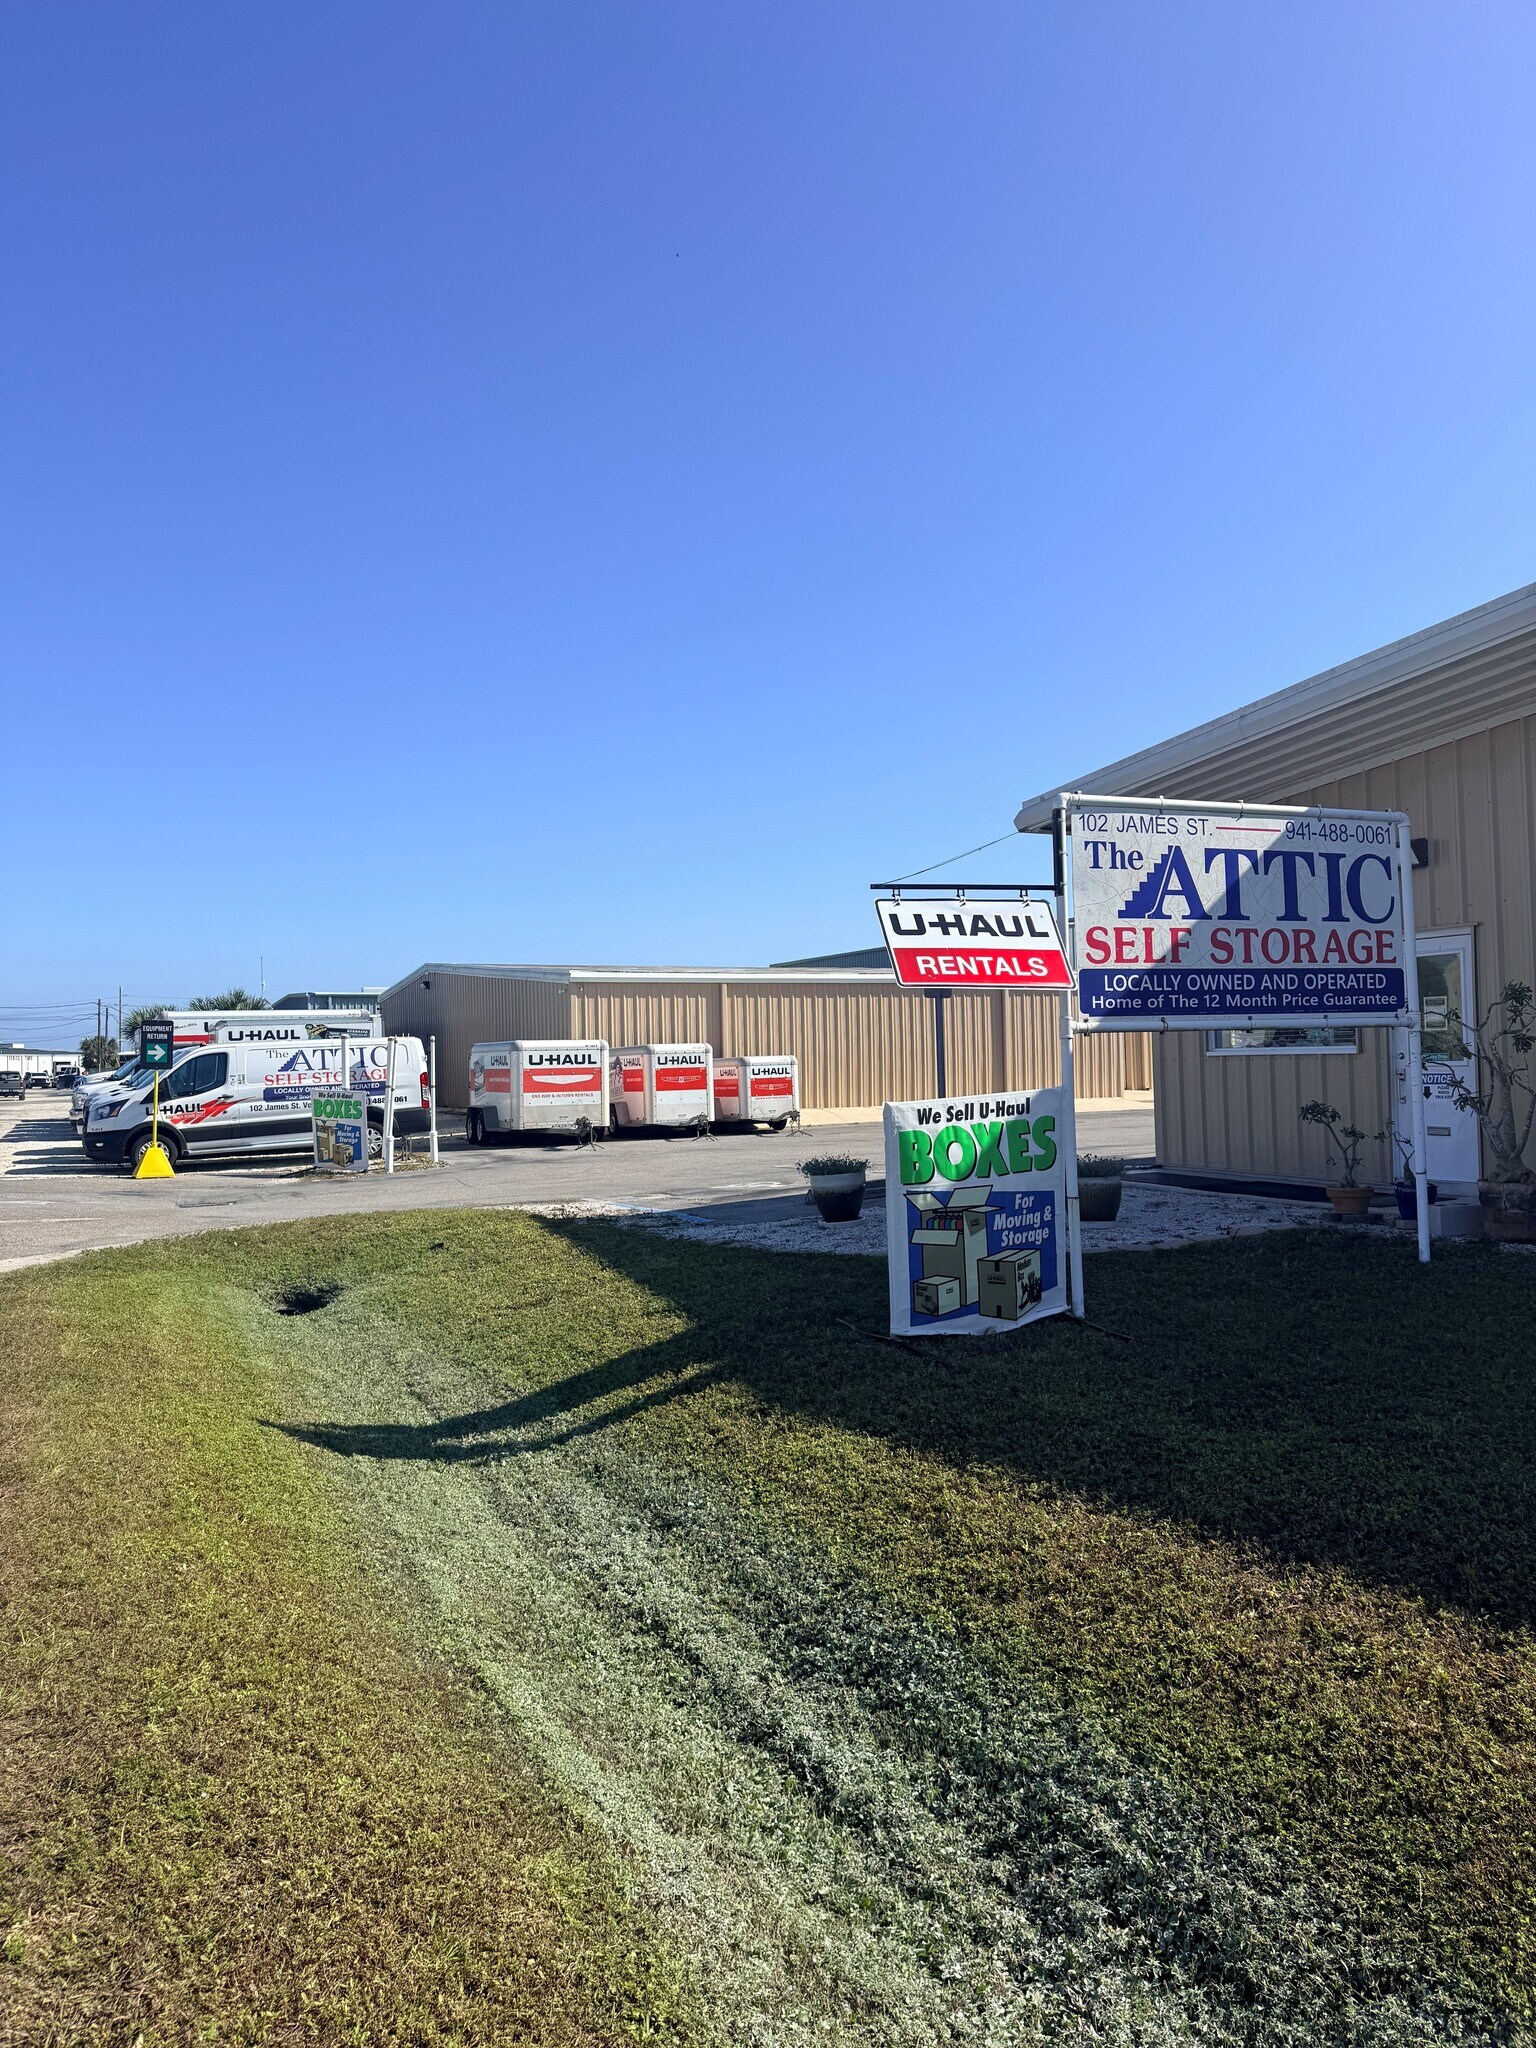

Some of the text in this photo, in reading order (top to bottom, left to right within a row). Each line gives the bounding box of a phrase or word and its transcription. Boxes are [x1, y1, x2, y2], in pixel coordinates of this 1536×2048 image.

[1078, 813, 1213, 837] 102 JAMES ST.
[1285, 821, 1392, 845] 941-488-0061
[1084, 840, 1395, 924] The ATTIC
[888, 913, 1050, 938] U-HAUL
[1085, 926, 1397, 965] SELF STORAGE
[915, 955, 1048, 977] RENTALS
[1104, 973, 1387, 992] LOCALLY OWNED AND OPERATED
[1092, 993, 1398, 1009] Home of The 12 Month Price Guarantee
[228, 1029, 300, 1041] U-HAUL
[266, 1050, 289, 1059] The
[528, 1053, 597, 1065] U-HAUL
[657, 1055, 705, 1065] U-HAUL
[264, 1072, 308, 1086] SELF
[751, 1067, 791, 1076] U-HAUL
[1422, 1074, 1453, 1084] NOTICE
[273, 1086, 304, 1095] LOCALLY
[264, 1103, 290, 1112] James
[291, 1102, 301, 1110] St.
[313, 1099, 363, 1119] BOXES
[917, 1097, 1031, 1126] We Sell U-Haul
[899, 1115, 1058, 1185] BOXES
[1015, 1193, 1035, 1210] For
[993, 1209, 1041, 1231] Moving
[1043, 1205, 1052, 1221] &
[1001, 1226, 1050, 1247] Storage
